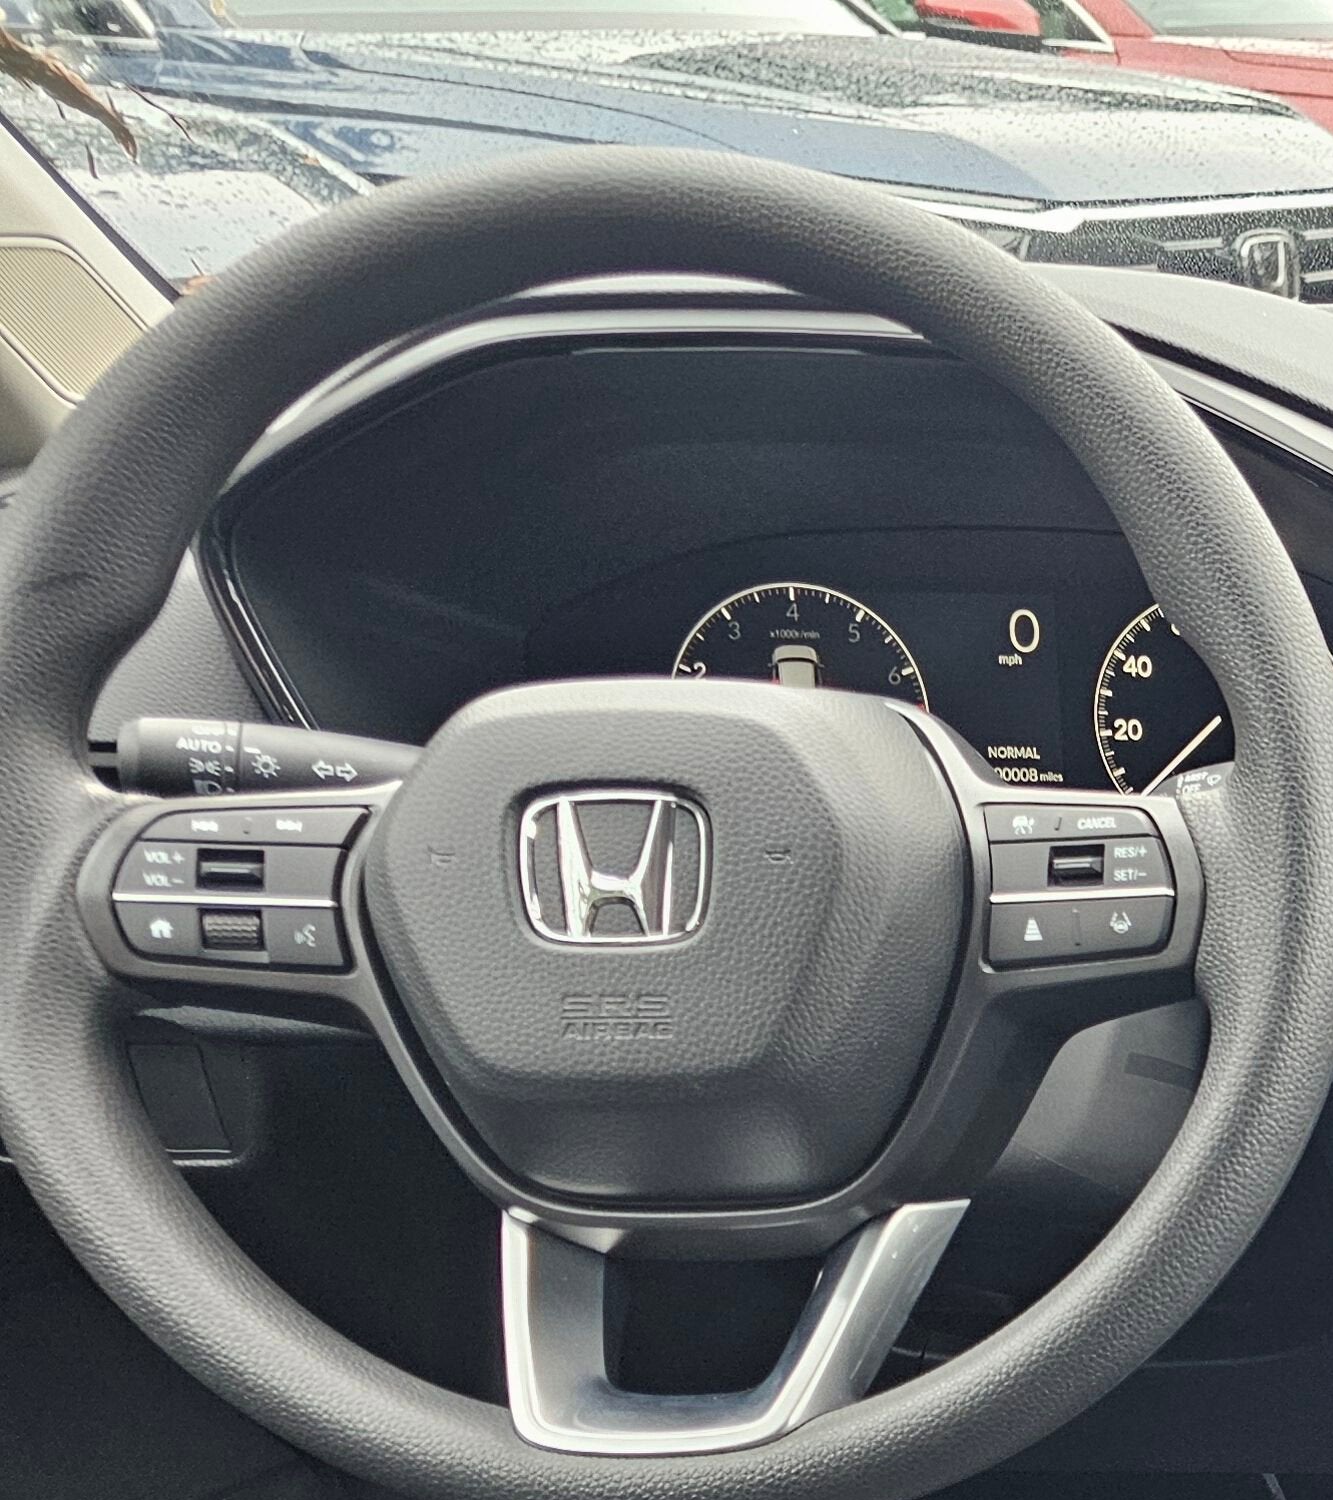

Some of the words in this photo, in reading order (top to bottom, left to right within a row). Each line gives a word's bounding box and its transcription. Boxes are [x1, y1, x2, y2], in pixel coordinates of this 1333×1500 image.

[786, 603, 799, 621] 4
[728, 622, 741, 640] 3
[848, 624, 860, 642] 5
[1009, 609, 1039, 653] 0
[998, 653, 1022, 666] mph
[1122, 655, 1152, 678] 40
[693, 662, 706, 680] 2
[888, 666, 901, 685] 6
[1114, 718, 1143, 741] 20
[176, 736, 222, 754] AUTO
[988, 746, 1040, 759] NORMAL
[1040, 772, 1063, 782] miles
[1077, 817, 1117, 830] CANCEL
[1114, 846, 1148, 858] RES/+
